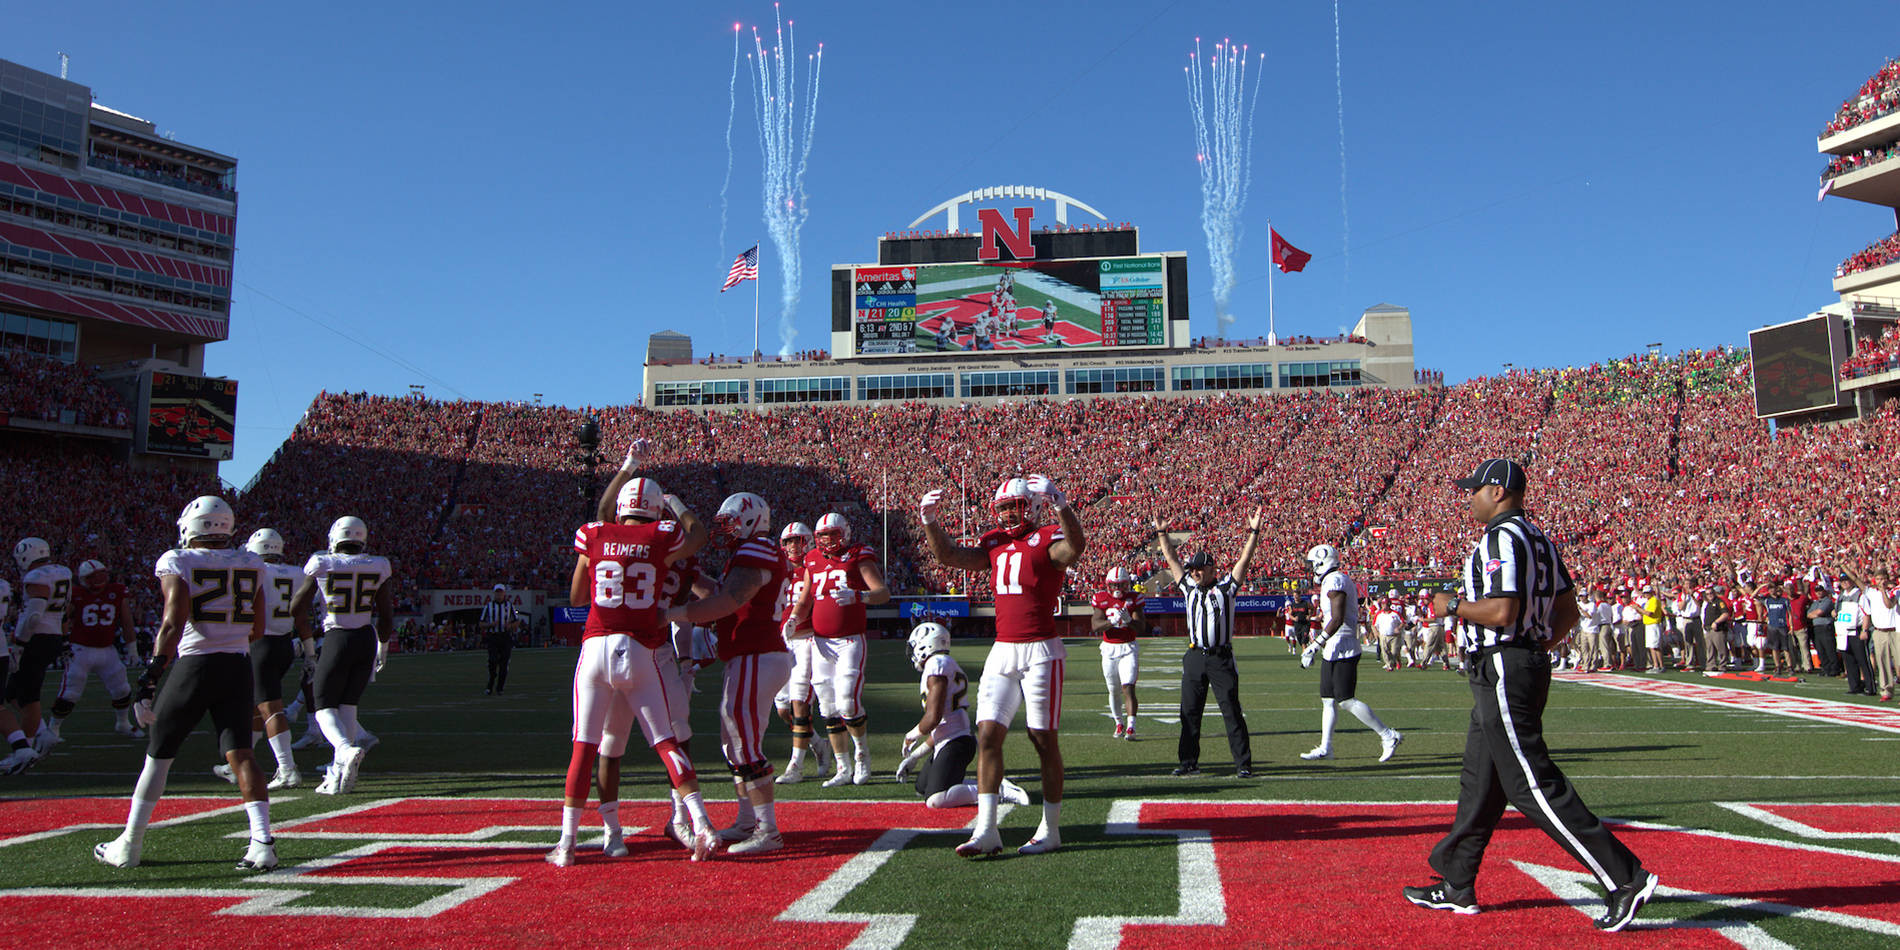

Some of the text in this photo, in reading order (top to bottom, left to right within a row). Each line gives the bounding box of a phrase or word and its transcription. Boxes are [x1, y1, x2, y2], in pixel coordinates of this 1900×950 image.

[885, 229, 973, 240] MEMORIAL
[977, 207, 1036, 260] N
[1043, 222, 1131, 234] STADIUM
[856, 271, 900, 282] Ameritas
[871, 308, 883, 318] 21
[887, 308, 901, 318] 20
[629, 498, 649, 510] 83
[603, 542, 651, 559] REIMERS
[996, 552, 1023, 595] 11
[326, 571, 381, 615] 56
[594, 560, 657, 609] 83
[813, 569, 848, 601] 73
[191, 568, 259, 624] 28
[443, 594, 523, 607] NEBRAKA
[81, 603, 116, 626] 63
